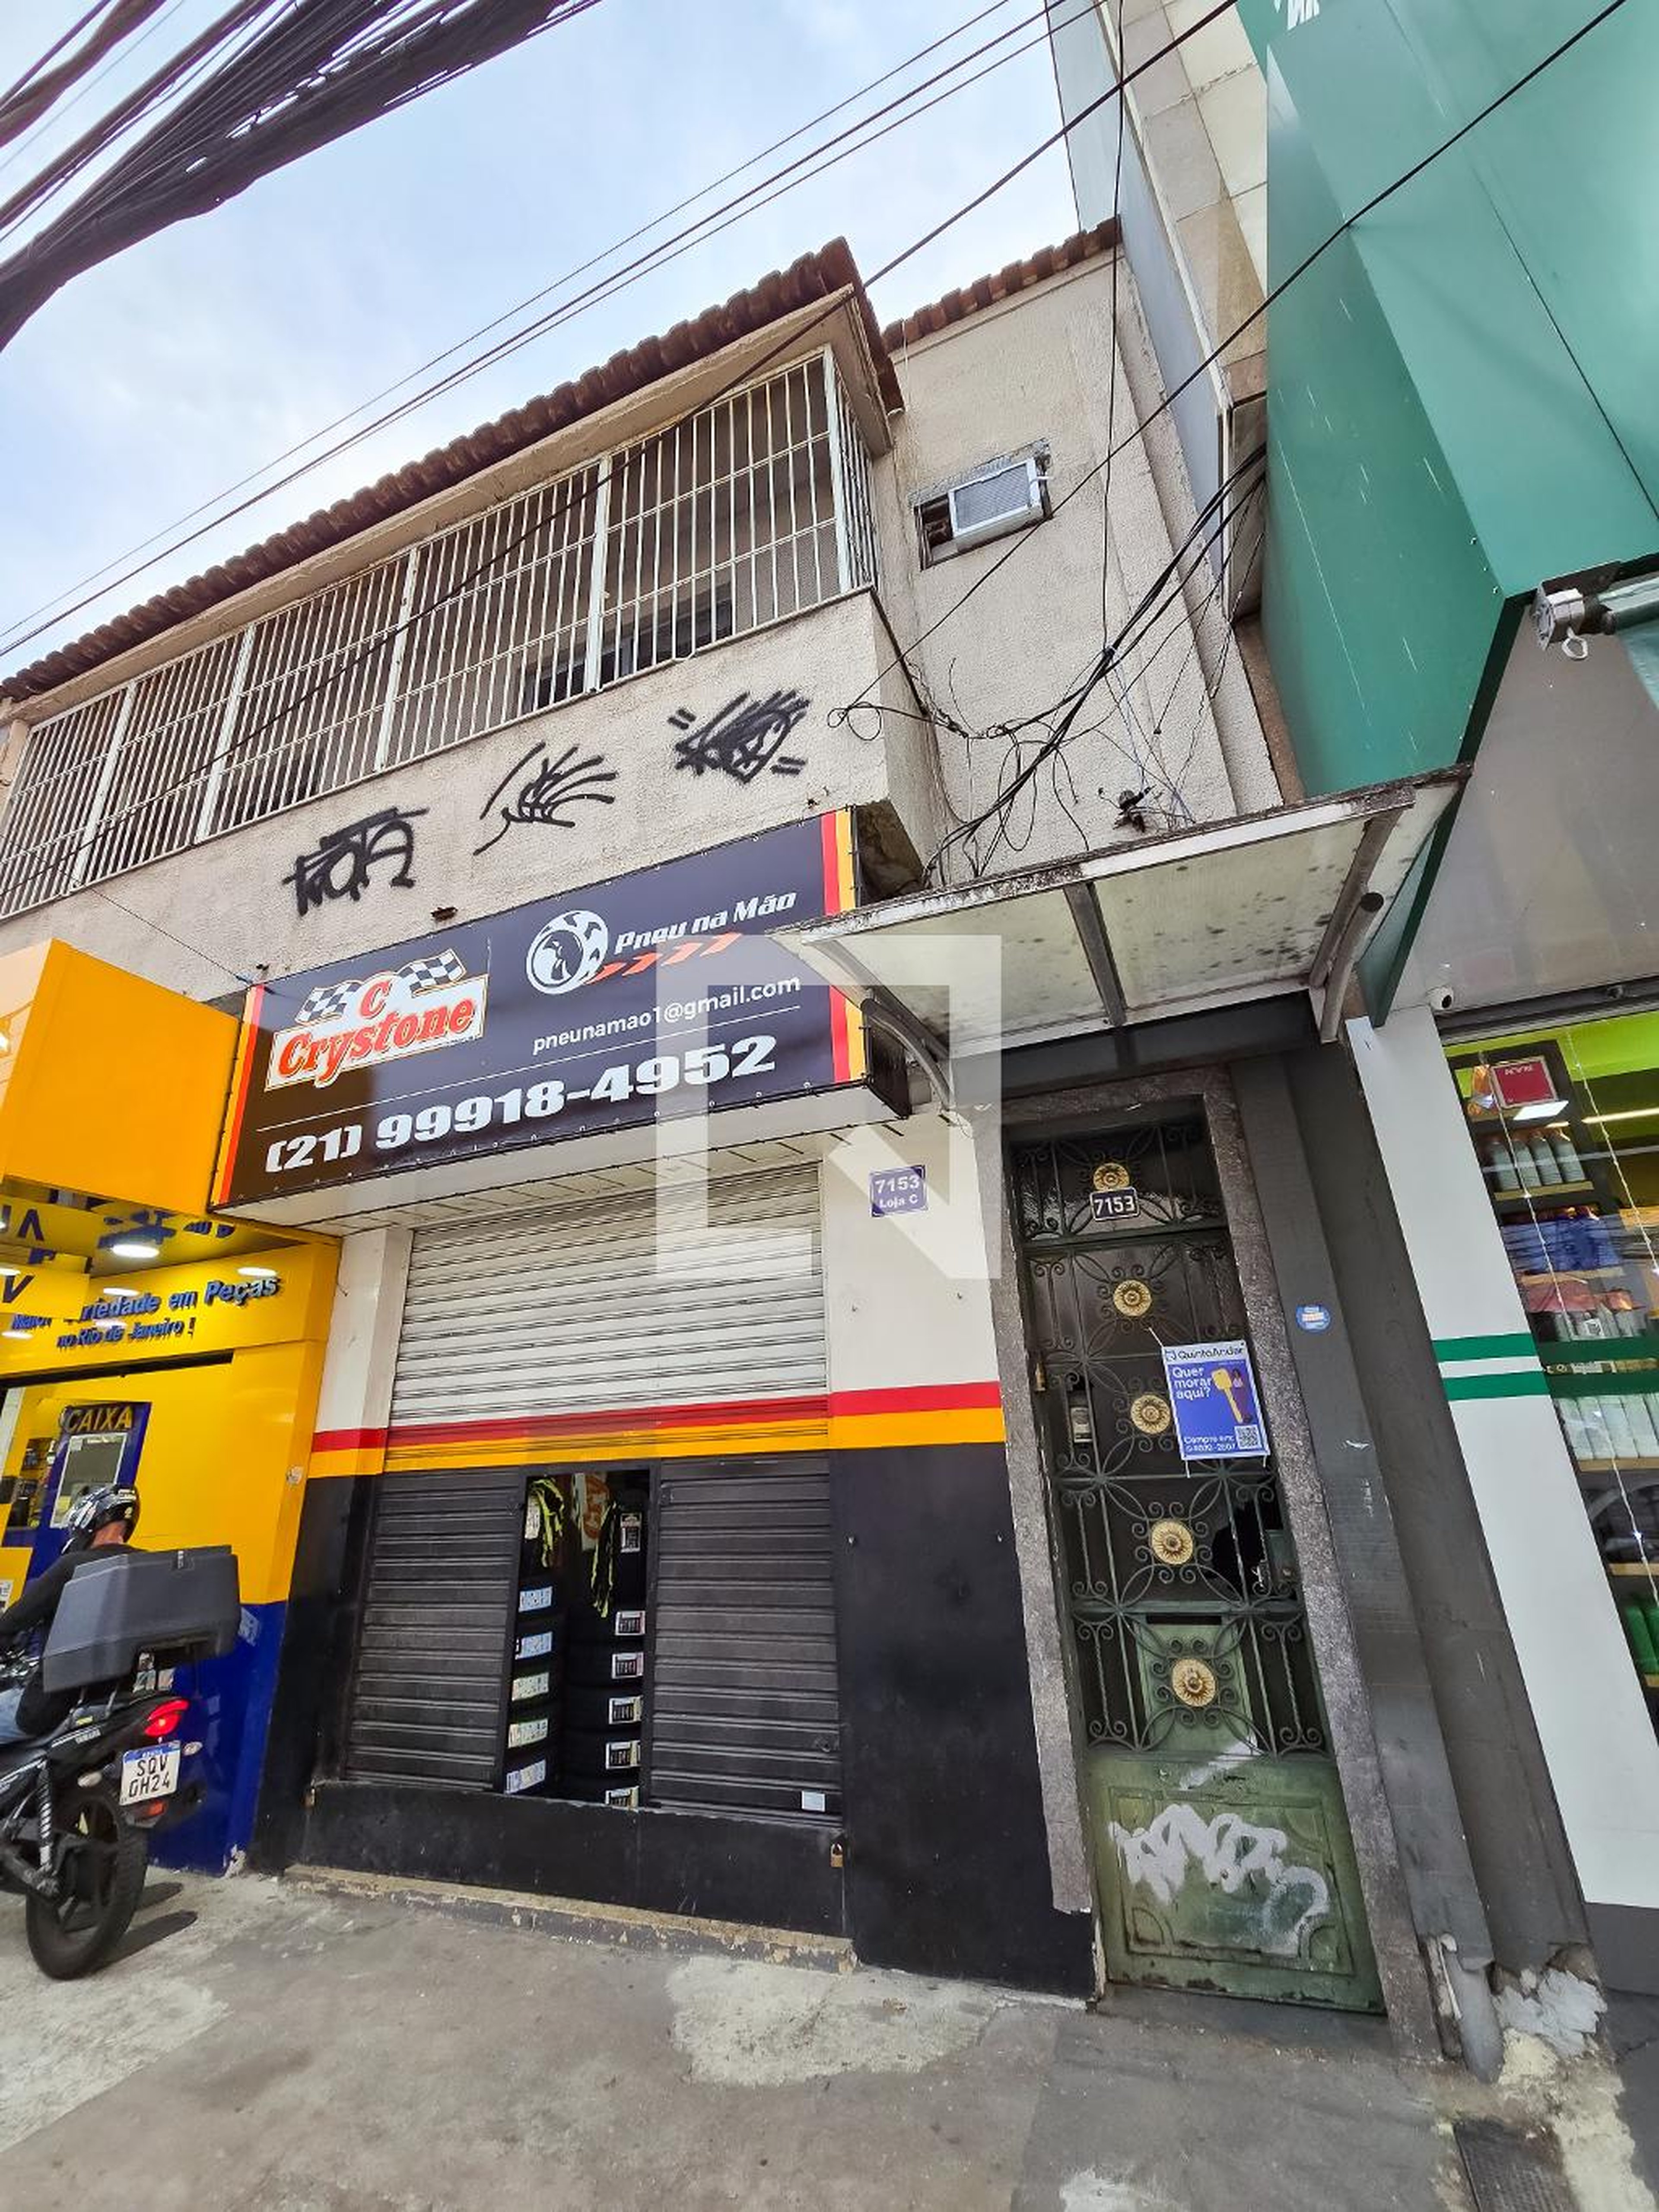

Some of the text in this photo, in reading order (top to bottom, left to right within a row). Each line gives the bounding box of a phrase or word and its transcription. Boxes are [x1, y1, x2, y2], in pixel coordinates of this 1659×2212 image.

[614, 891, 798, 955] Pneu na Mão
[359, 977, 393, 1018] C
[532, 975, 801, 1055] pneunamao1@gmail.com
[278, 997, 475, 1083] Crystone
[265, 1035, 776, 1172] (21) 99918-4952
[875, 1175, 920, 1193] 7153
[879, 1194, 918, 1209] Loja C
[1094, 1196, 1135, 1215] 7153
[169, 1291, 197, 1310] em
[204, 1277, 282, 1306] Peças
[78, 1327, 103, 1345] Rio
[104, 1325, 125, 1342] de
[127, 1318, 184, 1340] Janeiro
[1173, 1367, 1205, 1378] Quer
[1174, 1378, 1212, 1389] morar
[1176, 1387, 1211, 1400] aqui?
[67, 1406, 133, 1433] CAIXA
